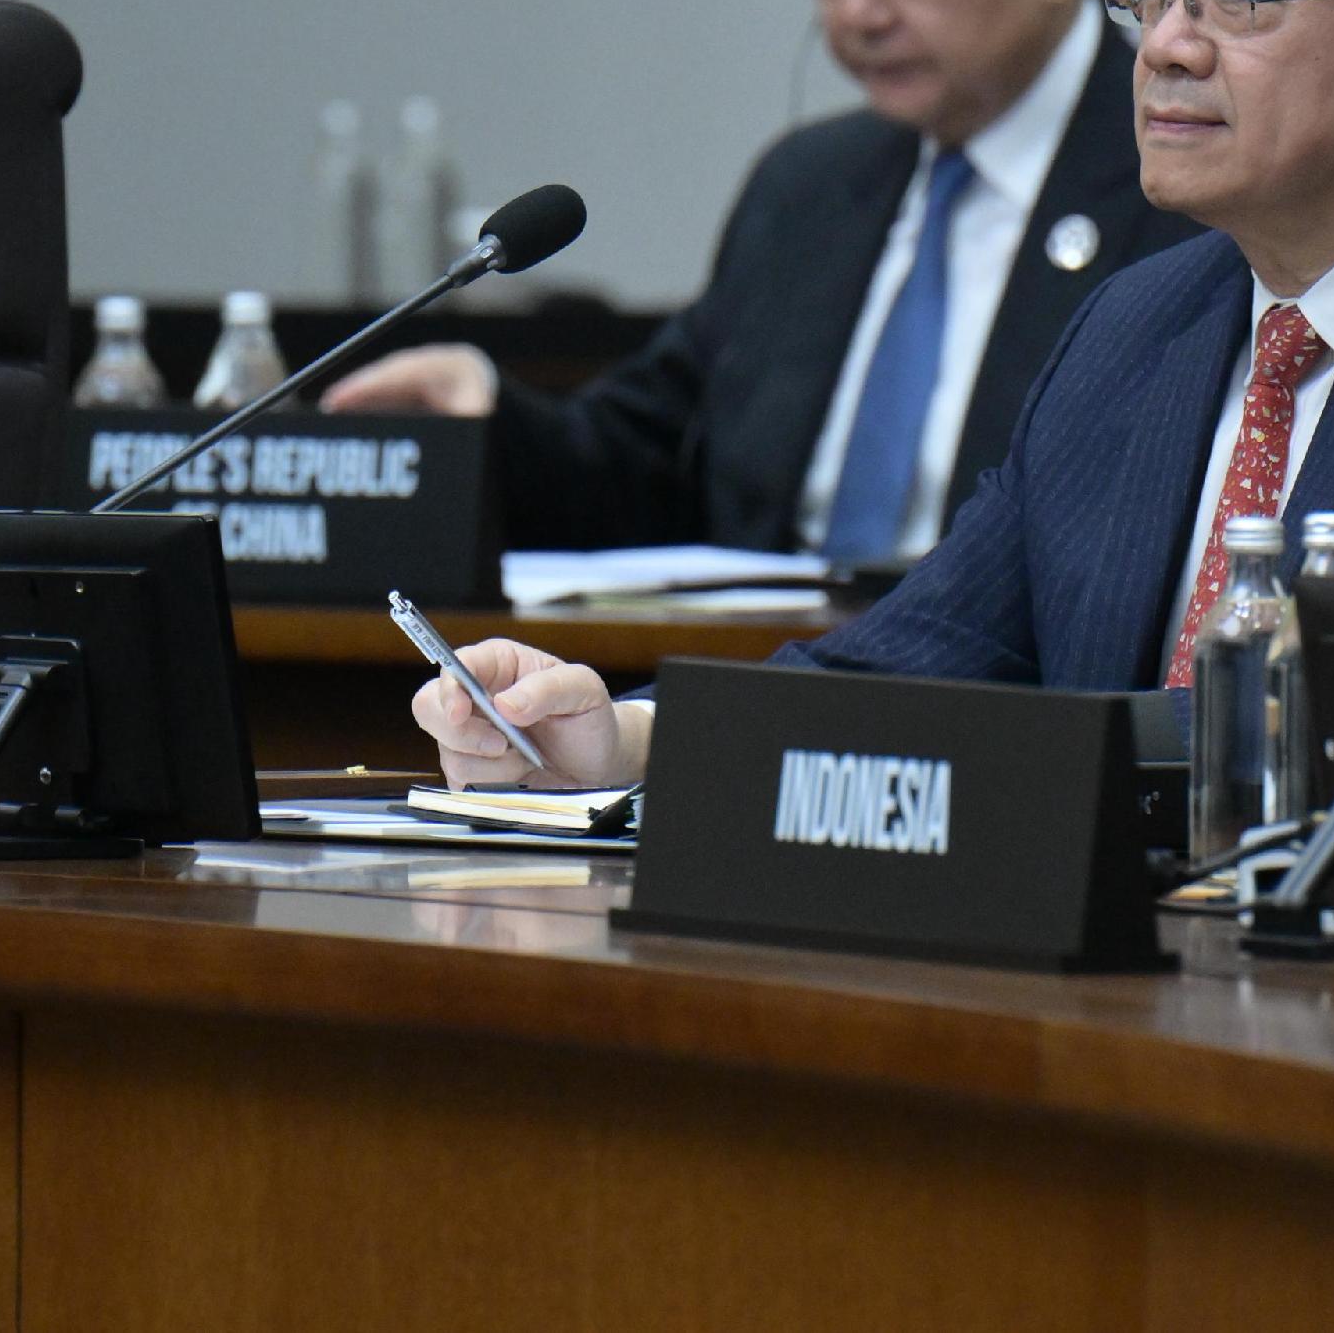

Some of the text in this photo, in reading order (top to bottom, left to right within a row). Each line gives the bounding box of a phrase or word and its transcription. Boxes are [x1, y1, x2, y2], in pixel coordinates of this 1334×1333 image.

[251, 436, 420, 498] REPUBLIC
[221, 502, 327, 562] CHINA
[774, 750, 952, 855] INDONESIA
